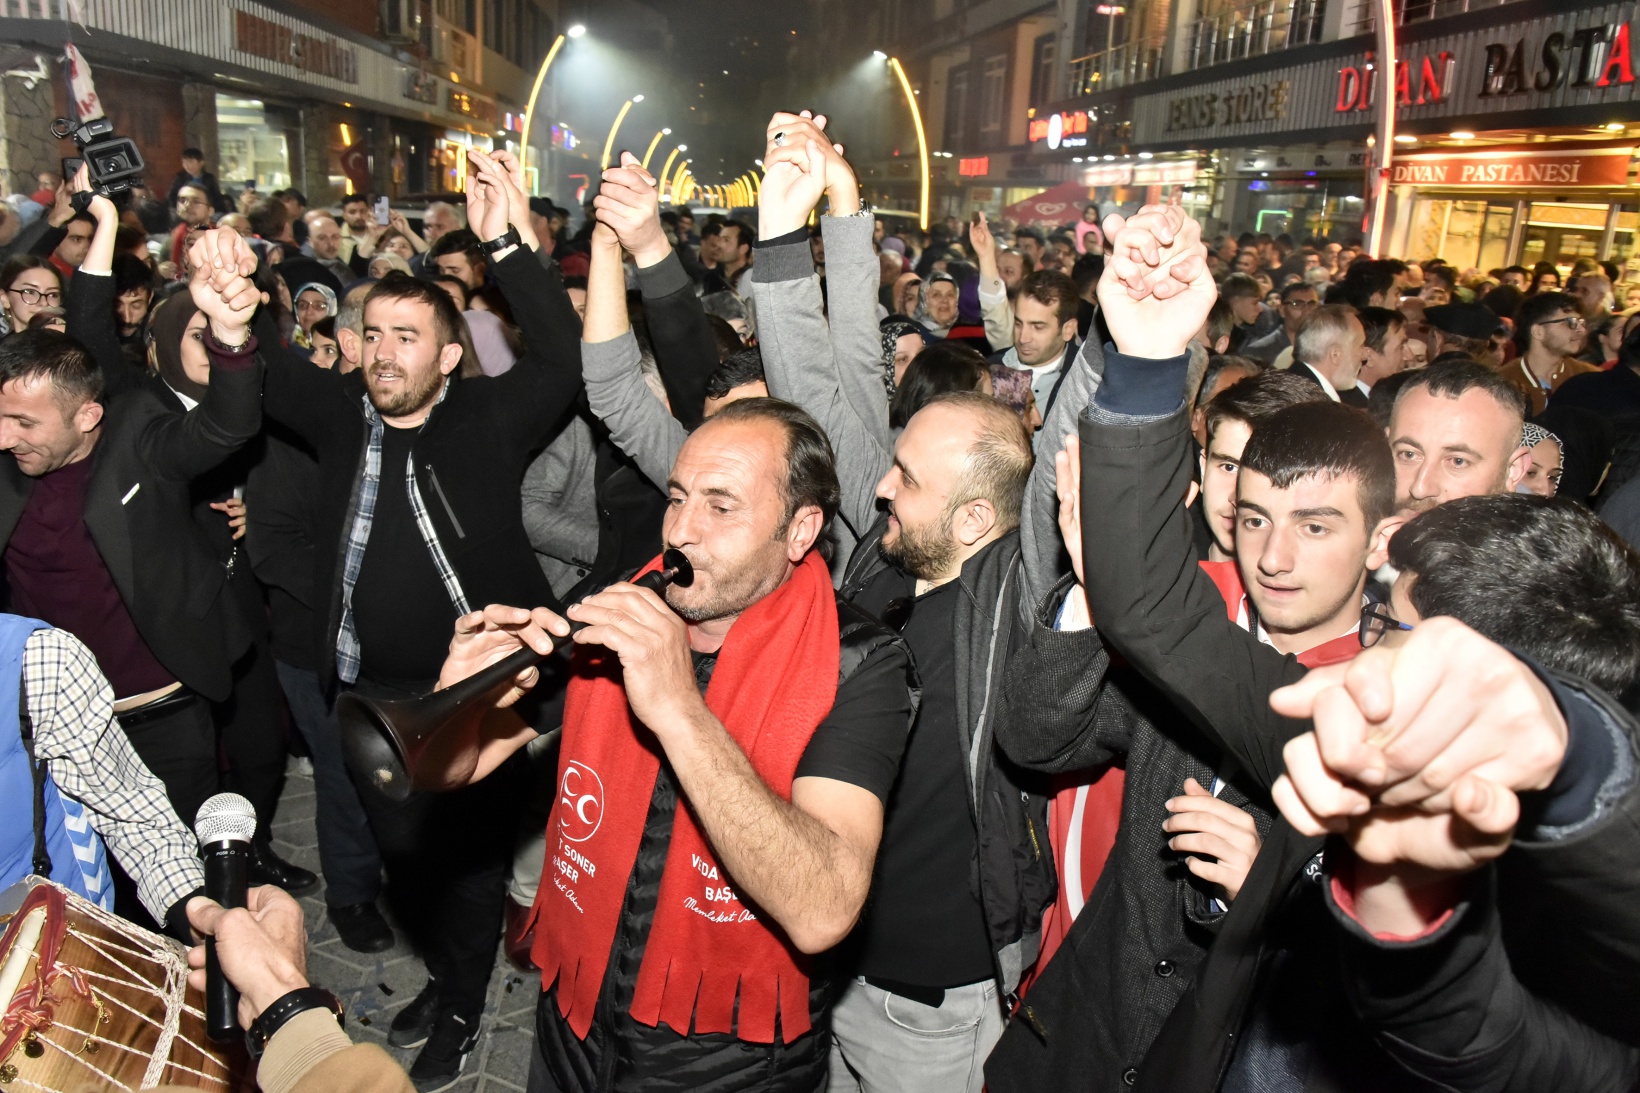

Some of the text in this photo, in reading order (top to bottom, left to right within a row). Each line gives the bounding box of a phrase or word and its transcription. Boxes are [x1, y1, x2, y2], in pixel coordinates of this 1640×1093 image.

[1335, 50, 1456, 113] DİAN
[1220, 81, 1290, 126] STORE
[1394, 160, 1581, 183] DİVAN PASTANESİ
[564, 844, 596, 878] SONER
[691, 853, 719, 881] VEDA
[705, 886, 738, 904] BAŞ
[683, 896, 738, 923] Memleket
